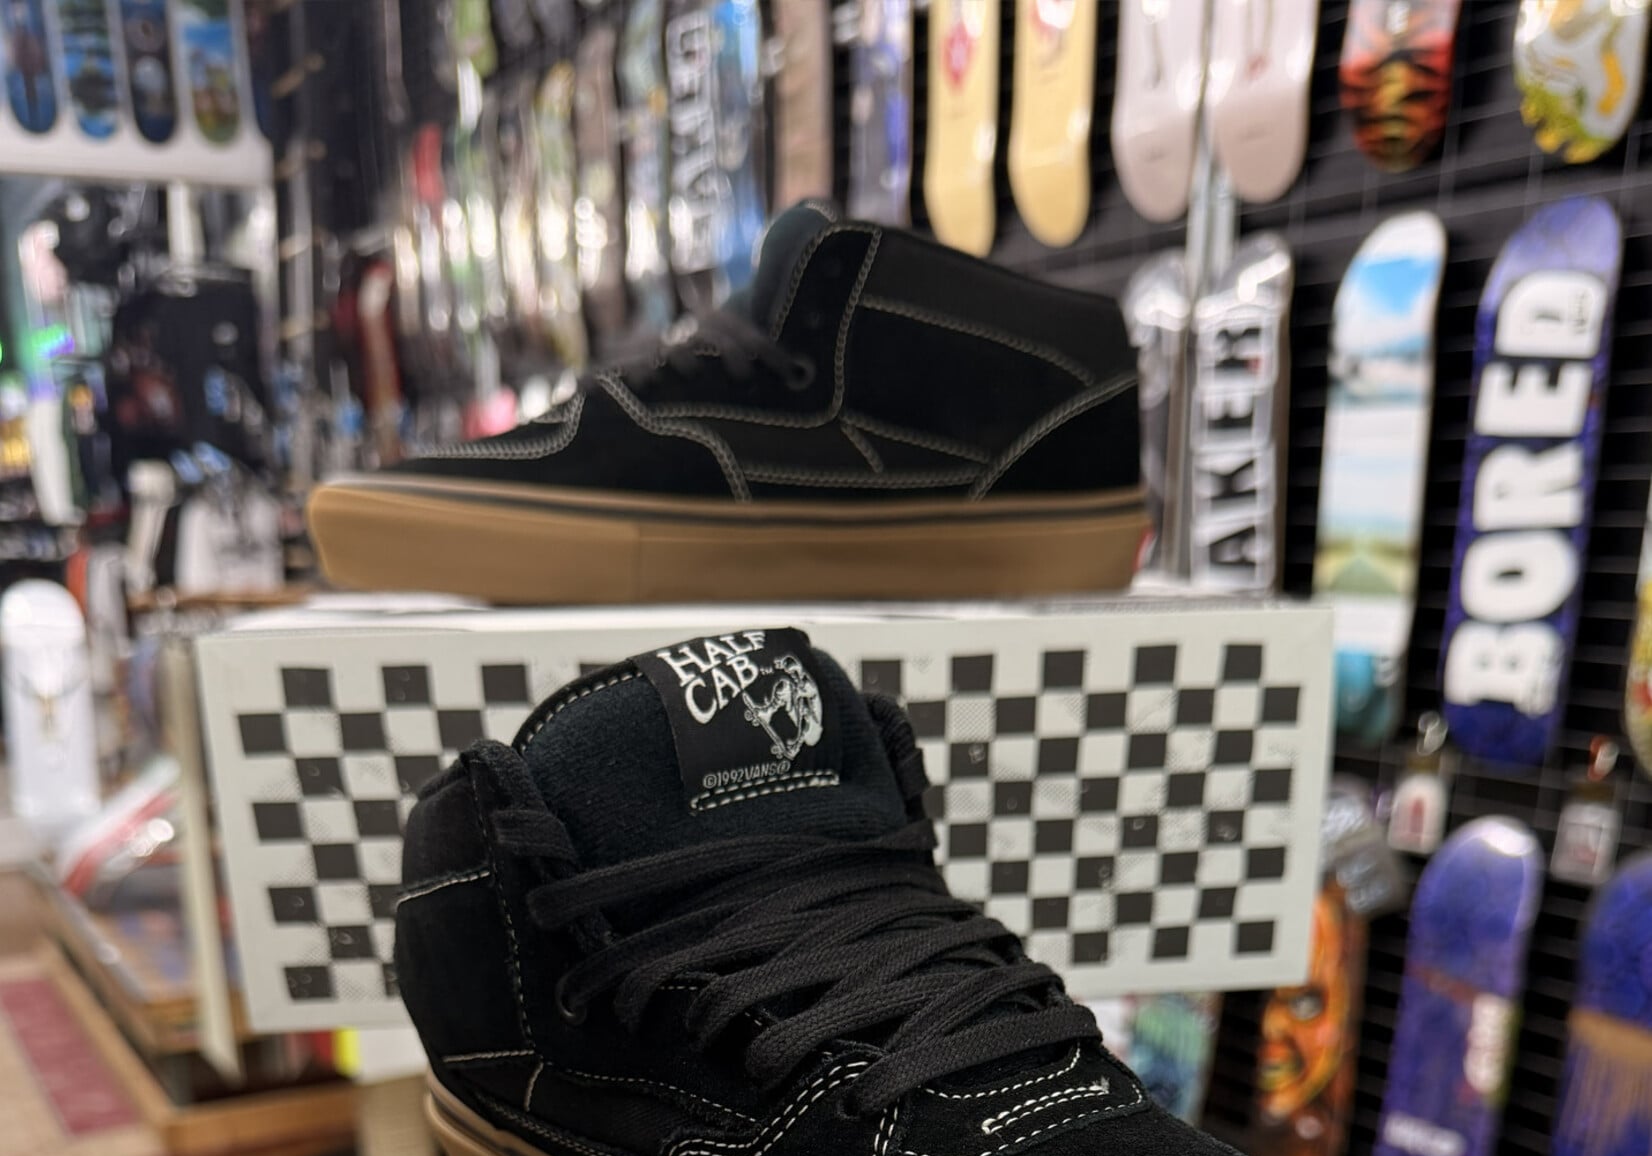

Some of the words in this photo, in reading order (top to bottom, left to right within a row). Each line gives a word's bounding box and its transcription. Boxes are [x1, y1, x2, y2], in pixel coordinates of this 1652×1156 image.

[1194, 308, 1275, 589] AKER
[1445, 270, 1608, 718] BORED
[656, 631, 765, 687] HALF
[685, 655, 759, 724] CAB
